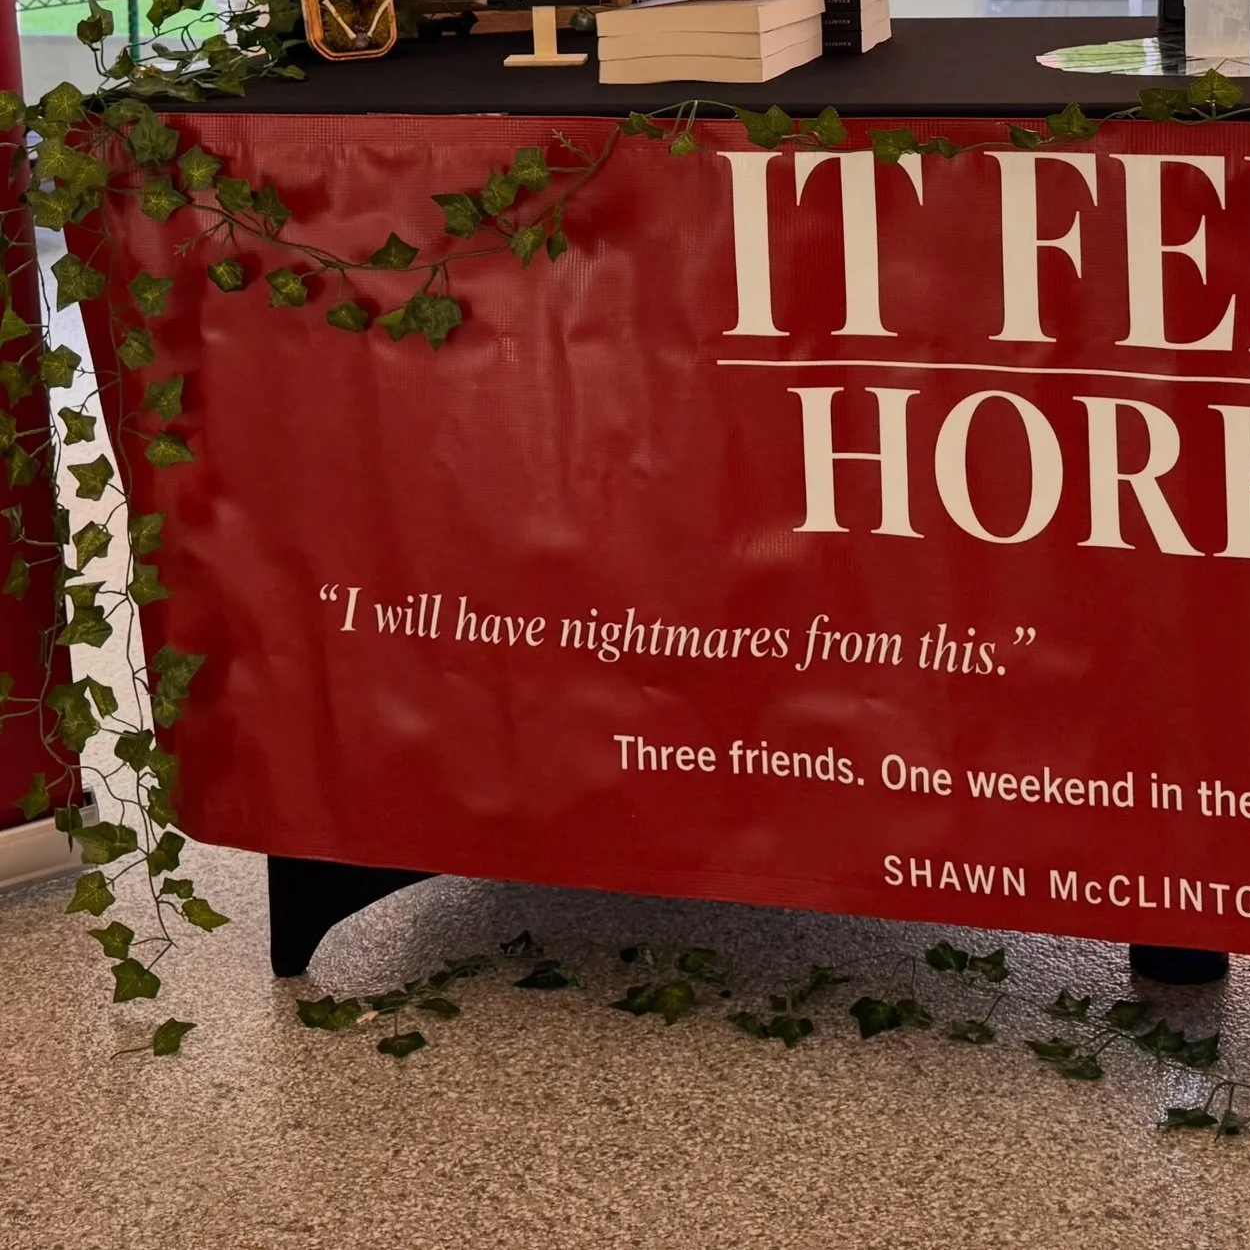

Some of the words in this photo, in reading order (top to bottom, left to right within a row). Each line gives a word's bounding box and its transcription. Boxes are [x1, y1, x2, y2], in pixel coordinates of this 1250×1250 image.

[716, 150, 924, 337] IT
[375, 593, 441, 641] will
[456, 596, 545, 647] have
[561, 607, 789, 662] nightmares
[796, 615, 903, 671] from
[613, 734, 717, 772] Three
[729, 739, 866, 786] friends.
[881, 754, 953, 795] One
[967, 767, 1134, 808] weekend
[1150, 772, 1183, 811] in
[883, 855, 1027, 896] SHAWN
